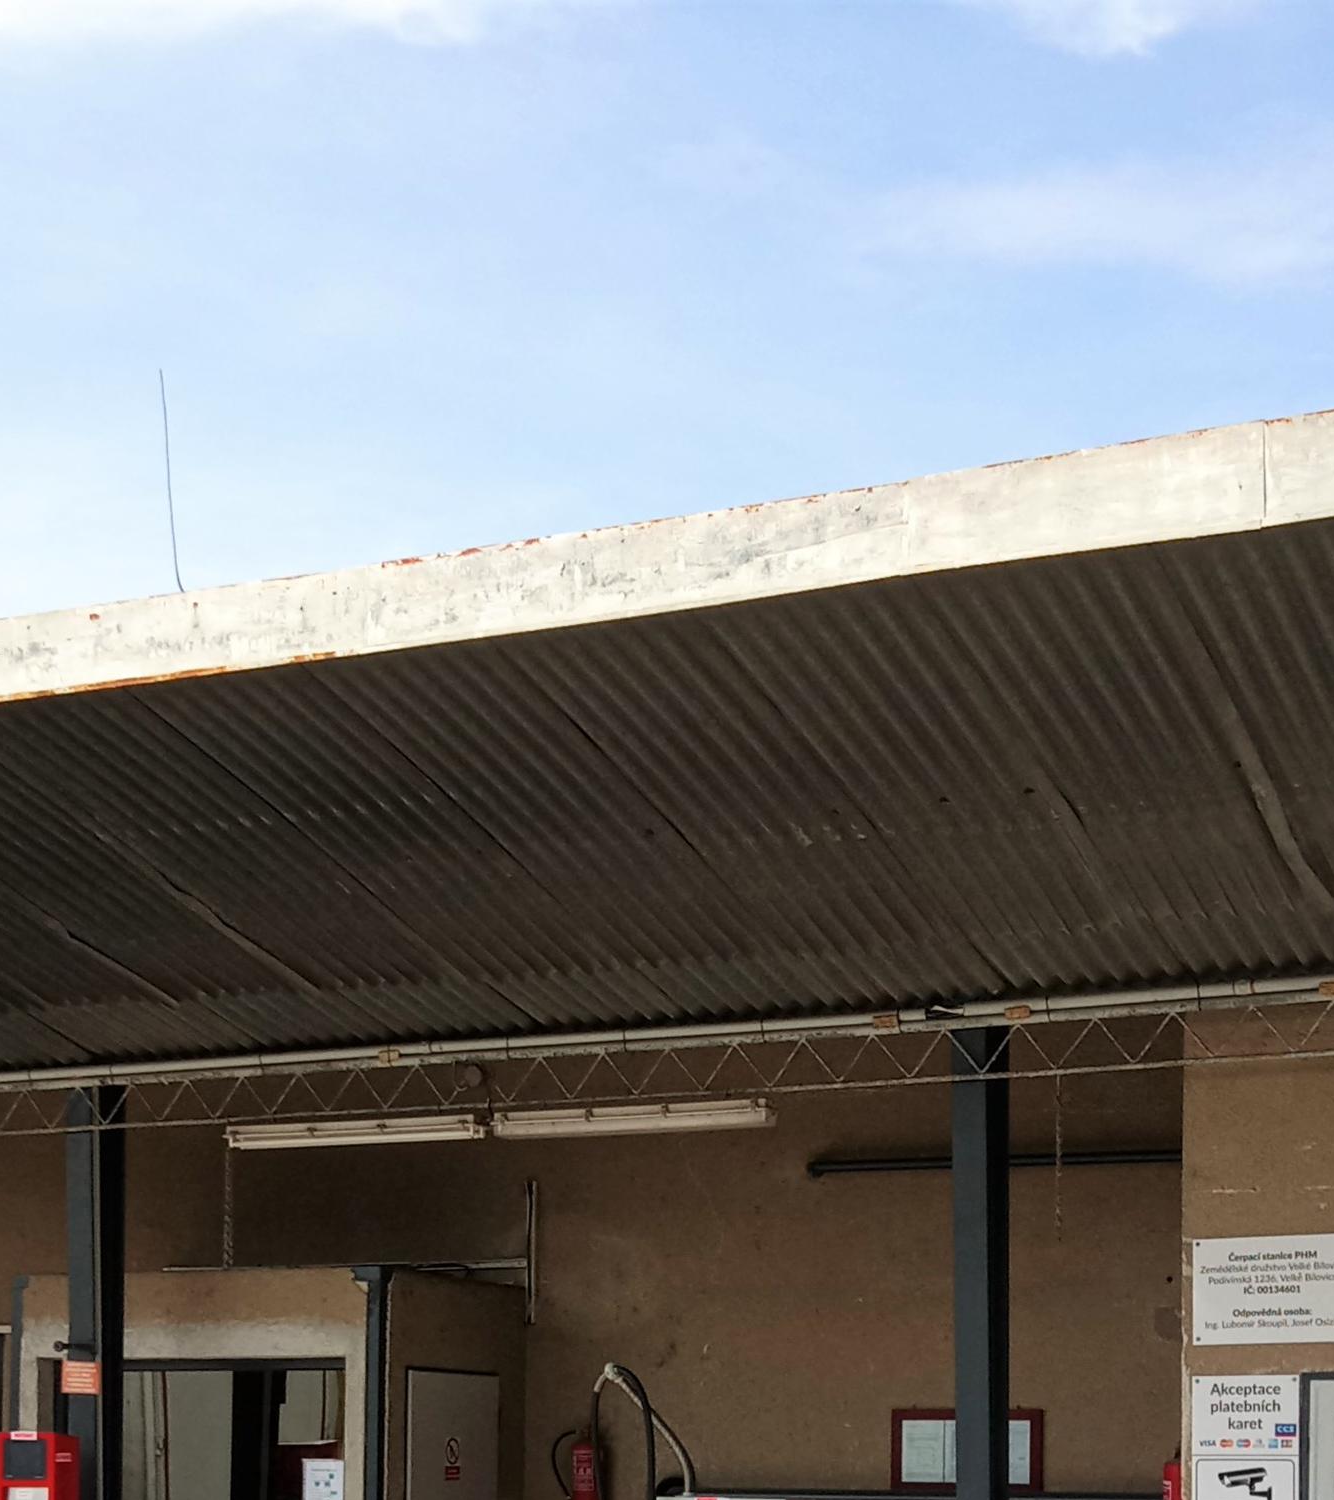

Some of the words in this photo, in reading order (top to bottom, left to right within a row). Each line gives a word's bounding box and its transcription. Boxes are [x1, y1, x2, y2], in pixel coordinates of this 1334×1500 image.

[1228, 1251, 1261, 1263] Čerpací
[1262, 1251, 1293, 1261] stanice
[1294, 1250, 1318, 1260] PHM
[1243, 1284, 1256, 1295] IČ:
[1257, 1284, 1301, 1294] 00134601
[1232, 1307, 1282, 1319] Odpovědná
[1283, 1306, 1312, 1317] osoba:
[1290, 1317, 1314, 1328] Josef
[1210, 1382, 1281, 1397] Akceptace
[1210, 1399, 1281, 1415] platebních
[1228, 1416, 1263, 1431] karet
